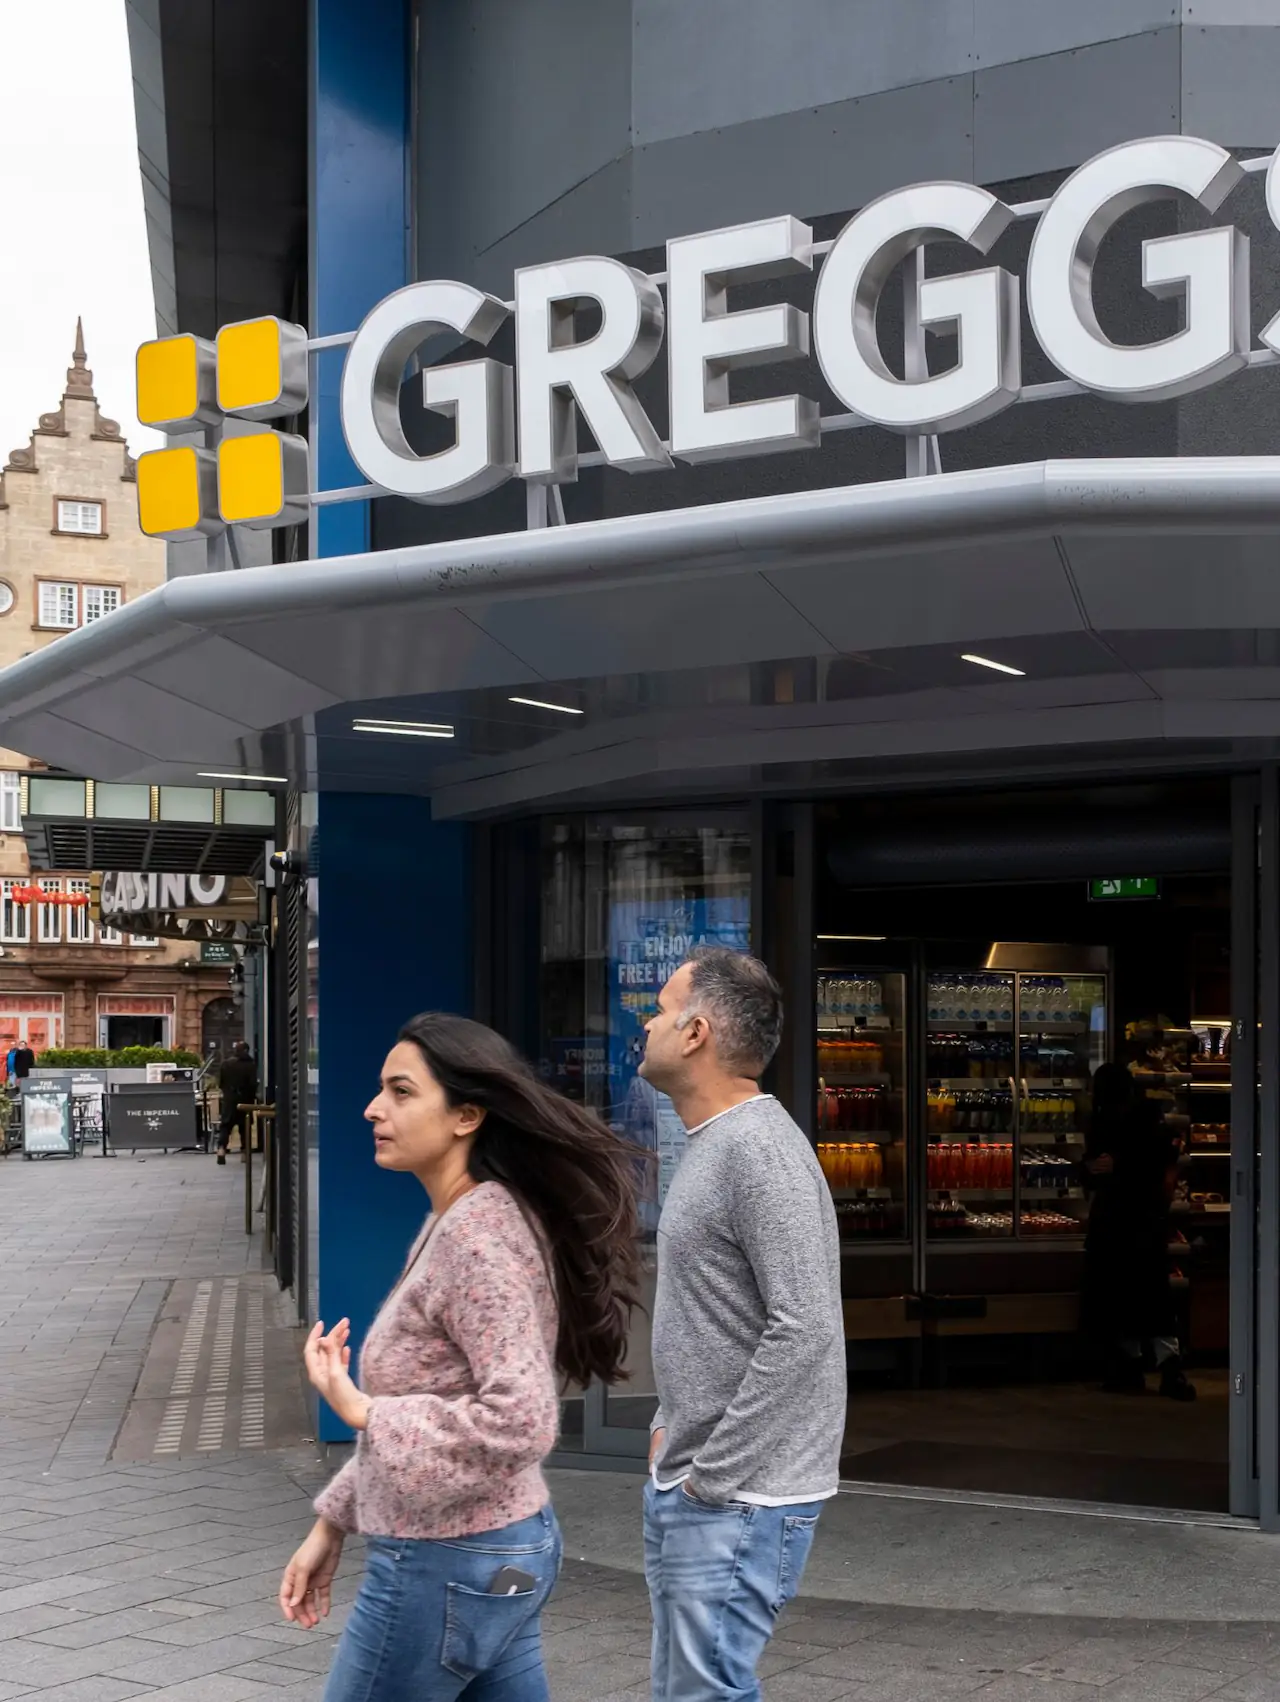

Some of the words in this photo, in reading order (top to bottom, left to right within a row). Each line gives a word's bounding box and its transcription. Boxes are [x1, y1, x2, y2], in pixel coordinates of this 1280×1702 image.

[101, 872, 226, 913] CASINO
[644, 935, 694, 958] ENJOY
[618, 963, 654, 984] FREE
[656, 961, 681, 983] HO
